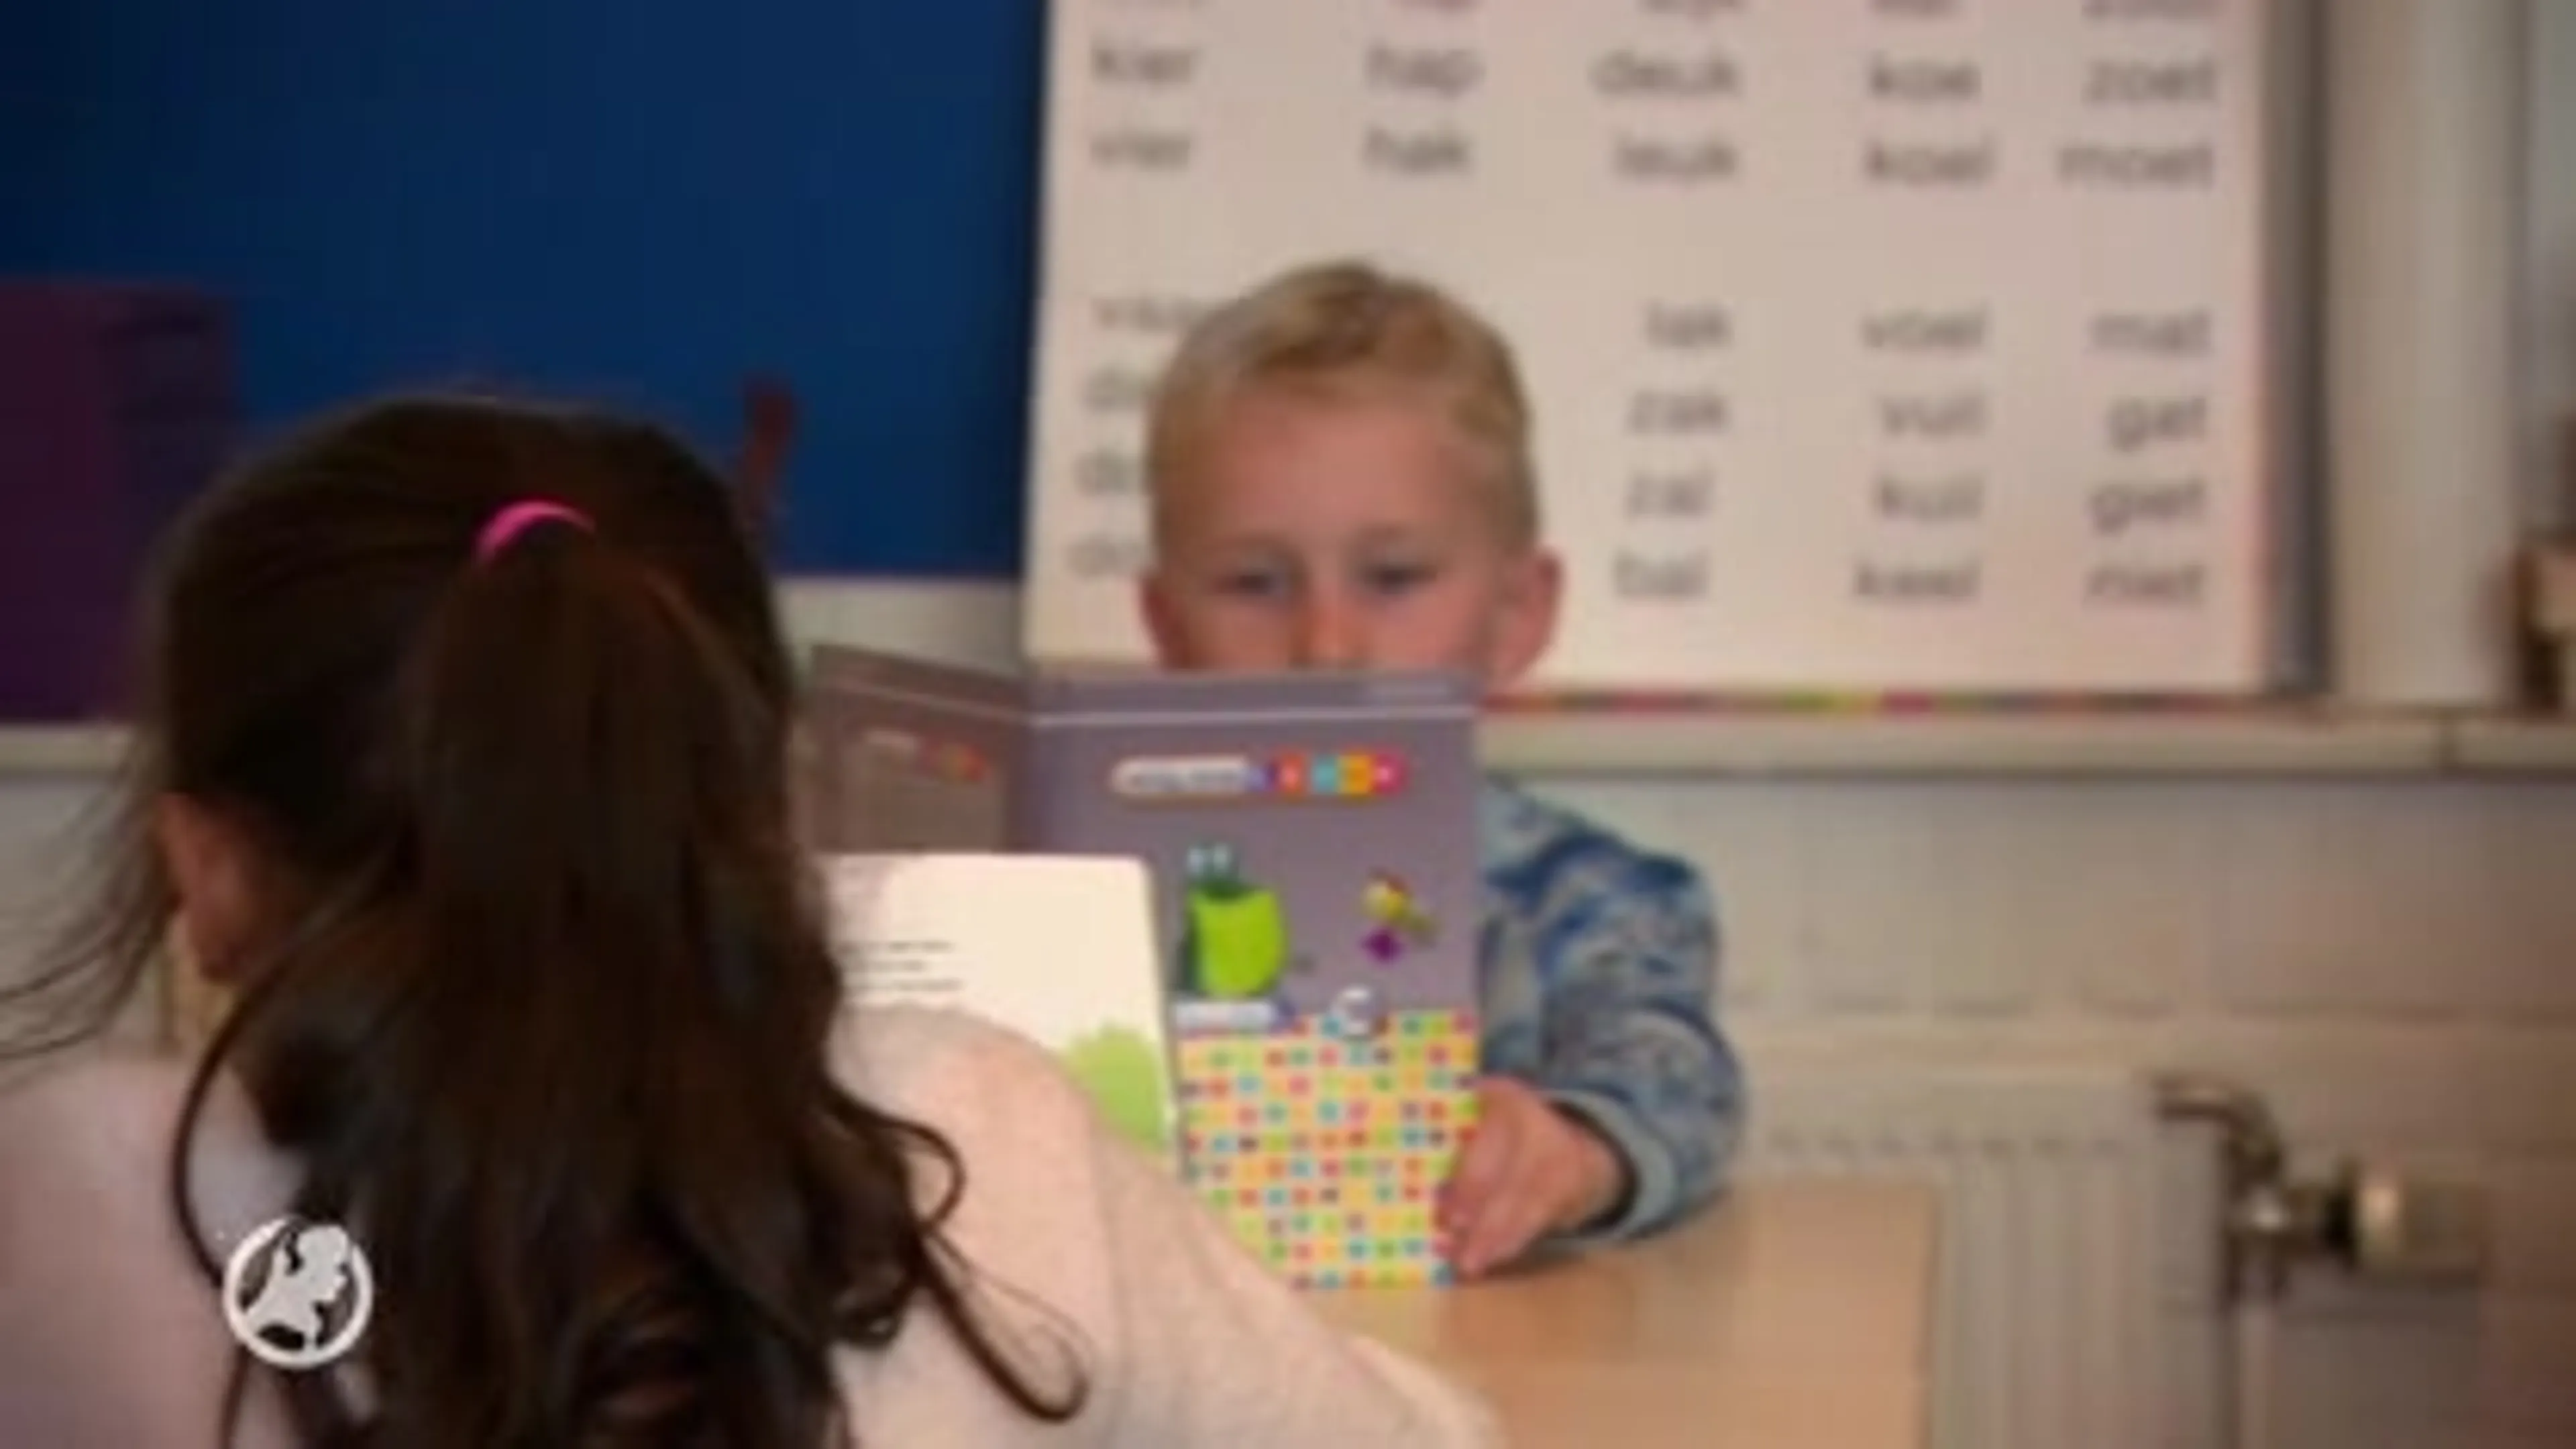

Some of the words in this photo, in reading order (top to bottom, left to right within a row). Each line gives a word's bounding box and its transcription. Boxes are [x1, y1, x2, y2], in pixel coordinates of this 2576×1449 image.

[1364, 43, 1484, 100] hap
[1868, 58, 1981, 102] koe
[1364, 127, 1470, 176] hak
[1628, 389, 1731, 435] zak
